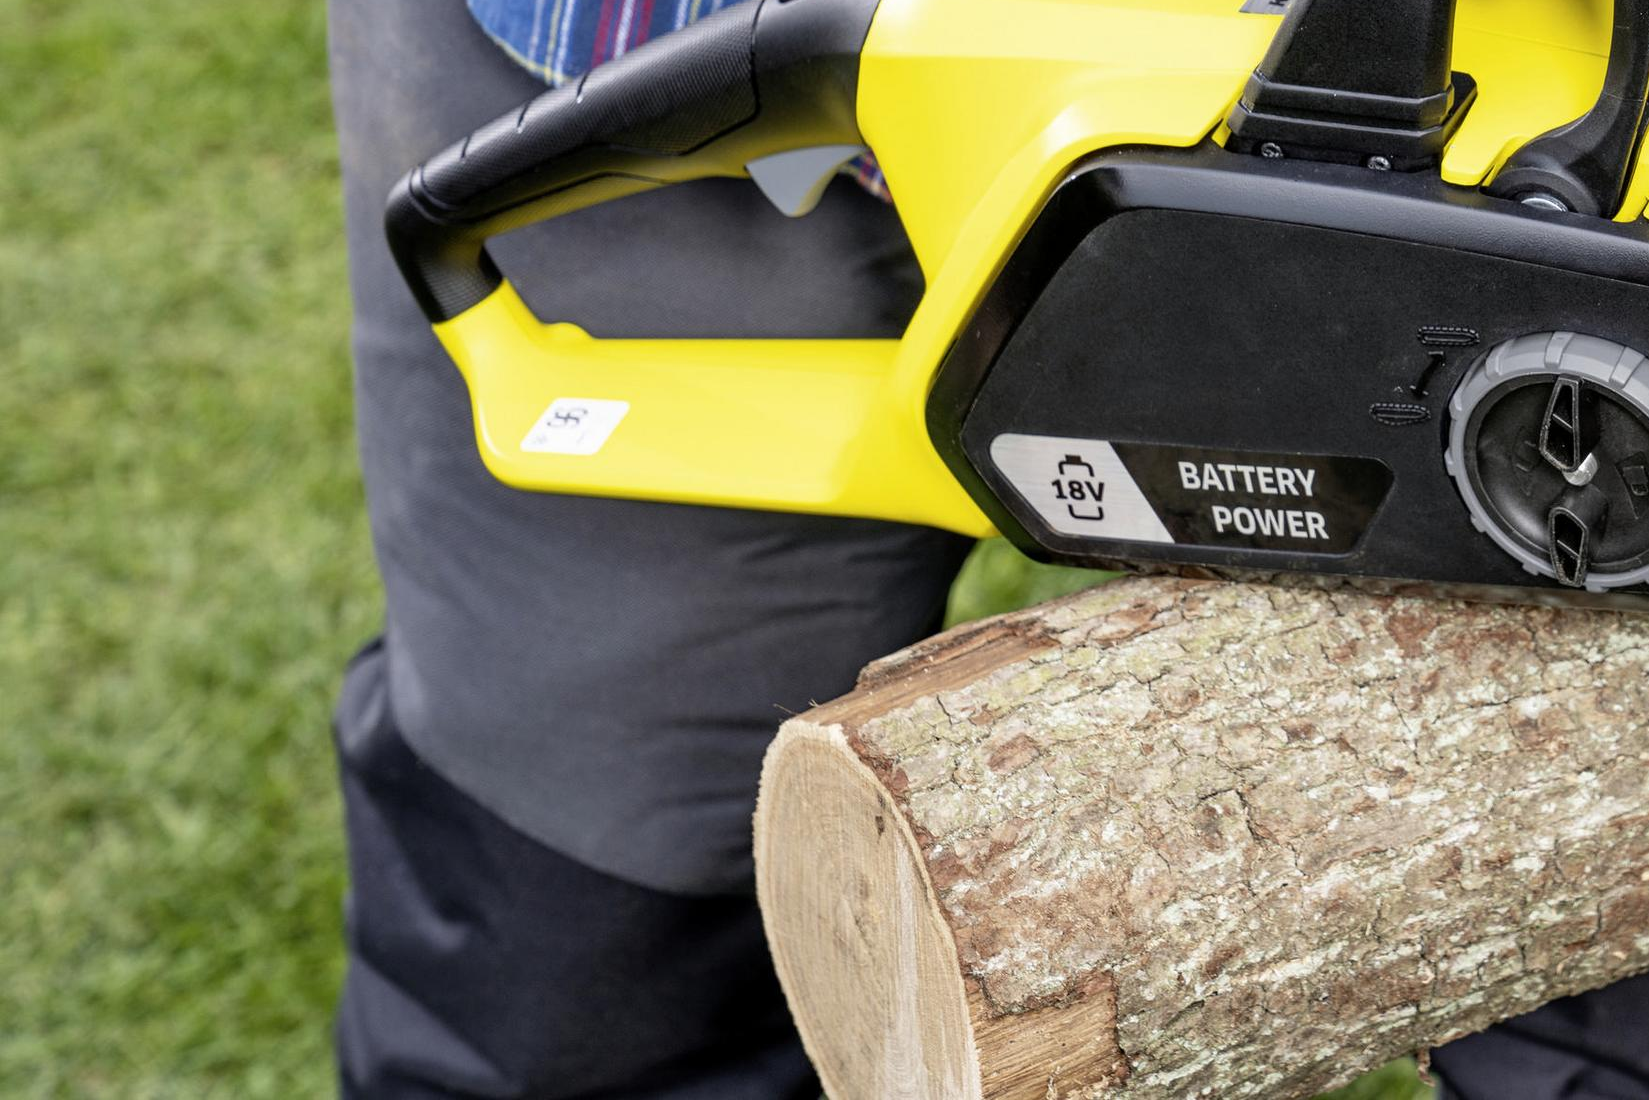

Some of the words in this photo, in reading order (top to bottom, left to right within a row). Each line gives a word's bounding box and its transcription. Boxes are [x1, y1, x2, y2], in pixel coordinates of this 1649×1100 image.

[1051, 477, 1106, 503] 18V
[1177, 460, 1316, 498] BATTERY
[1211, 505, 1330, 540] POWER
